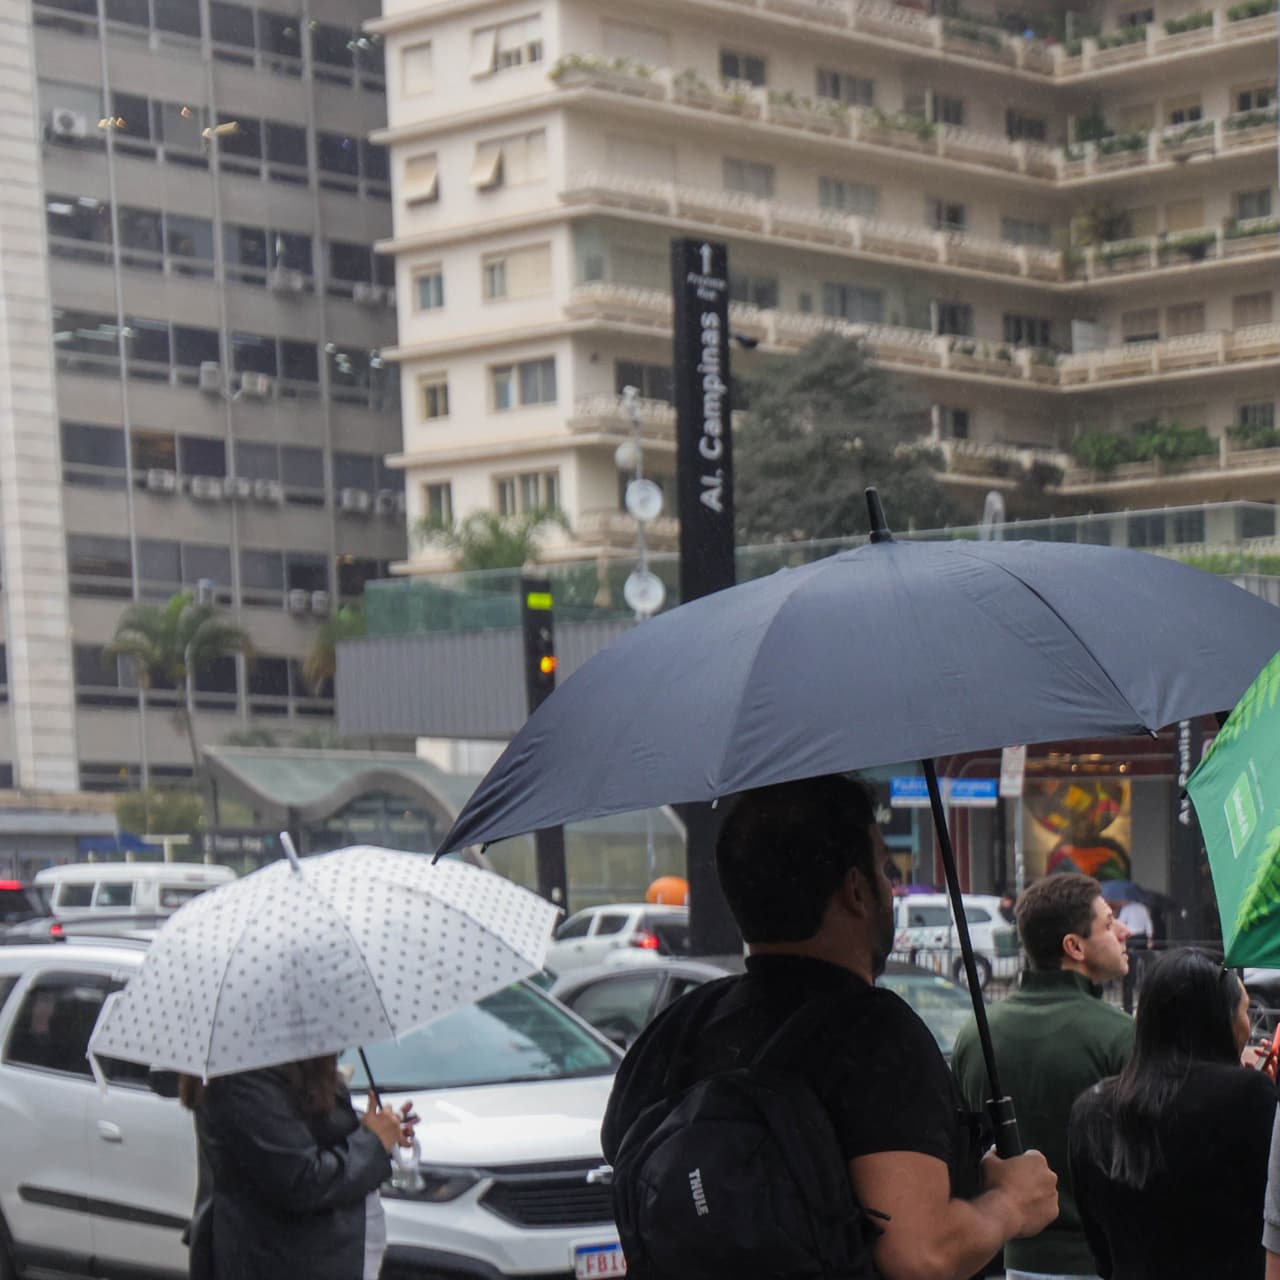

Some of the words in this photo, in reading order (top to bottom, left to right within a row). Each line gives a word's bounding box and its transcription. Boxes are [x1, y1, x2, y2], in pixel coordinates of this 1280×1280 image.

[697, 311, 728, 460] Campinas
[701, 468, 724, 513] Al.
[689, 1168, 709, 1216] THULE
